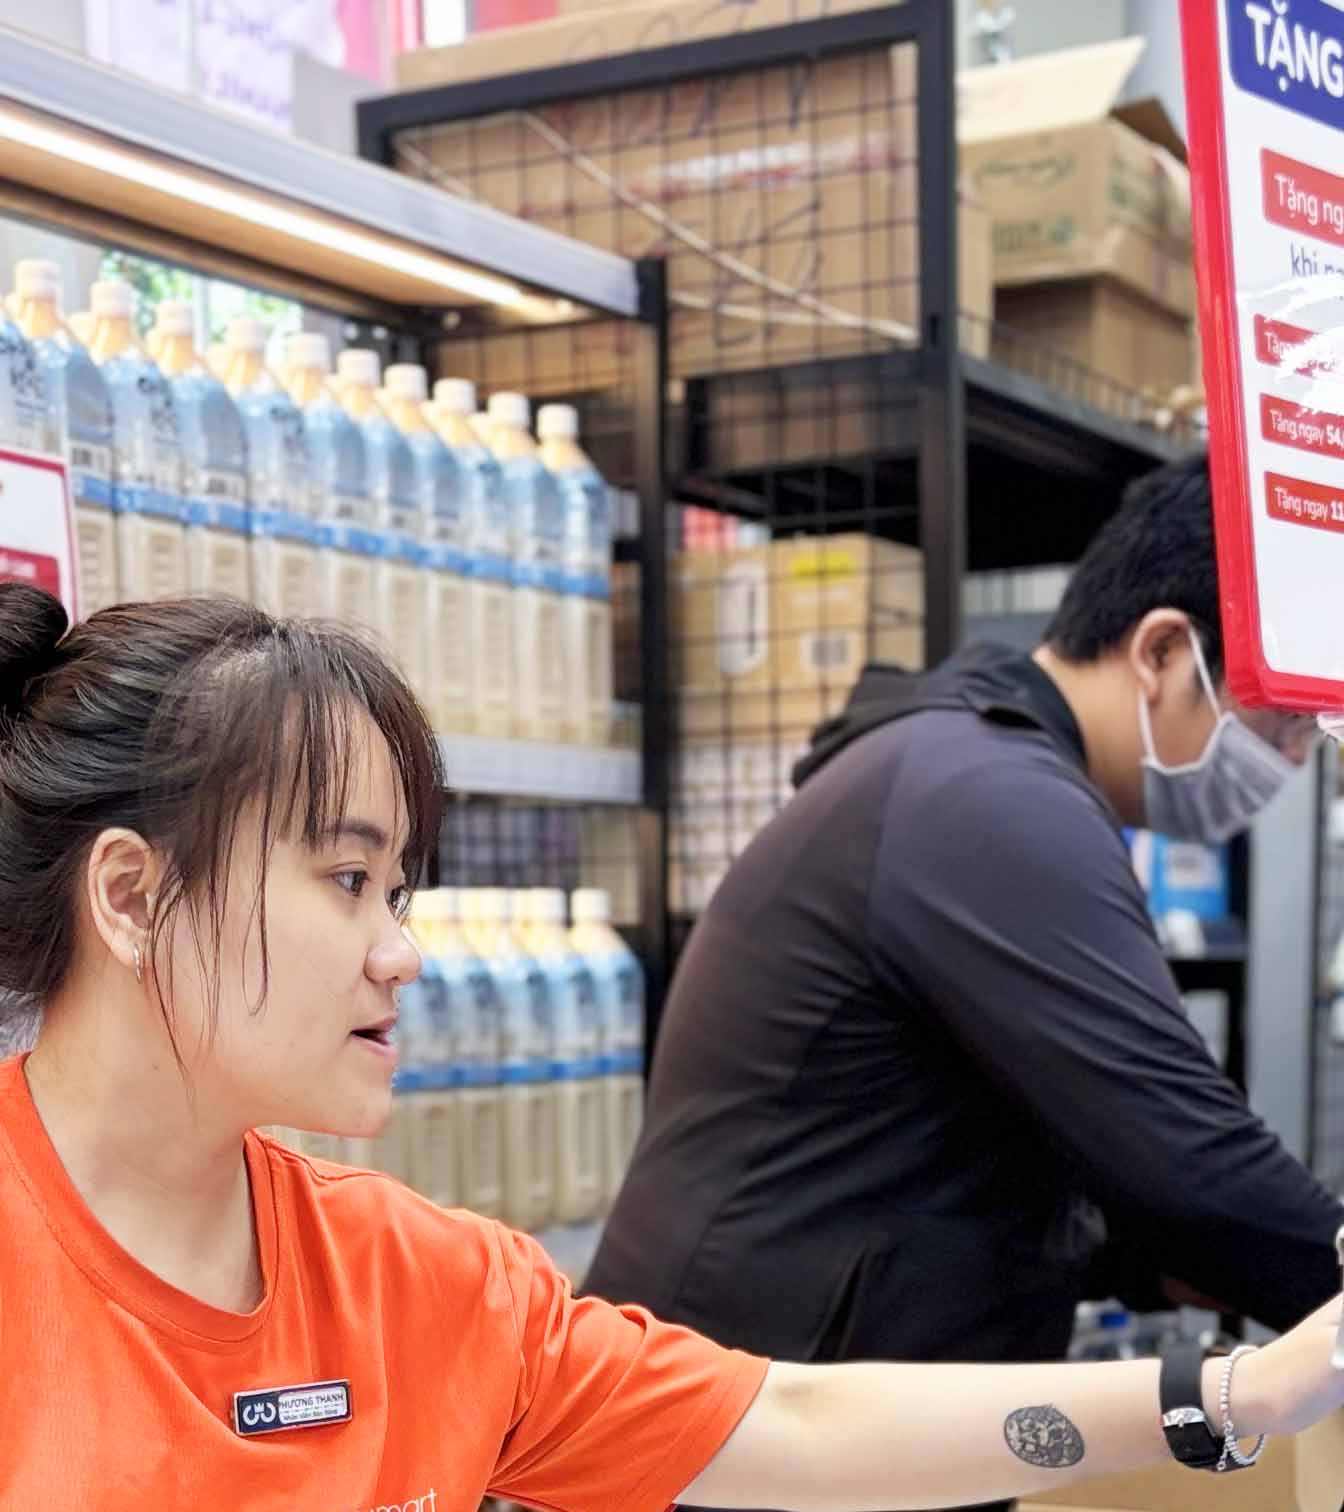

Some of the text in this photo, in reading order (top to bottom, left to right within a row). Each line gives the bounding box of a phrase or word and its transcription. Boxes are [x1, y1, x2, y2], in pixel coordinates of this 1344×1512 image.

[1246, 0, 1344, 97] TẶNG
[1274, 173, 1318, 225] Tặng
[1290, 240, 1318, 277] khi
